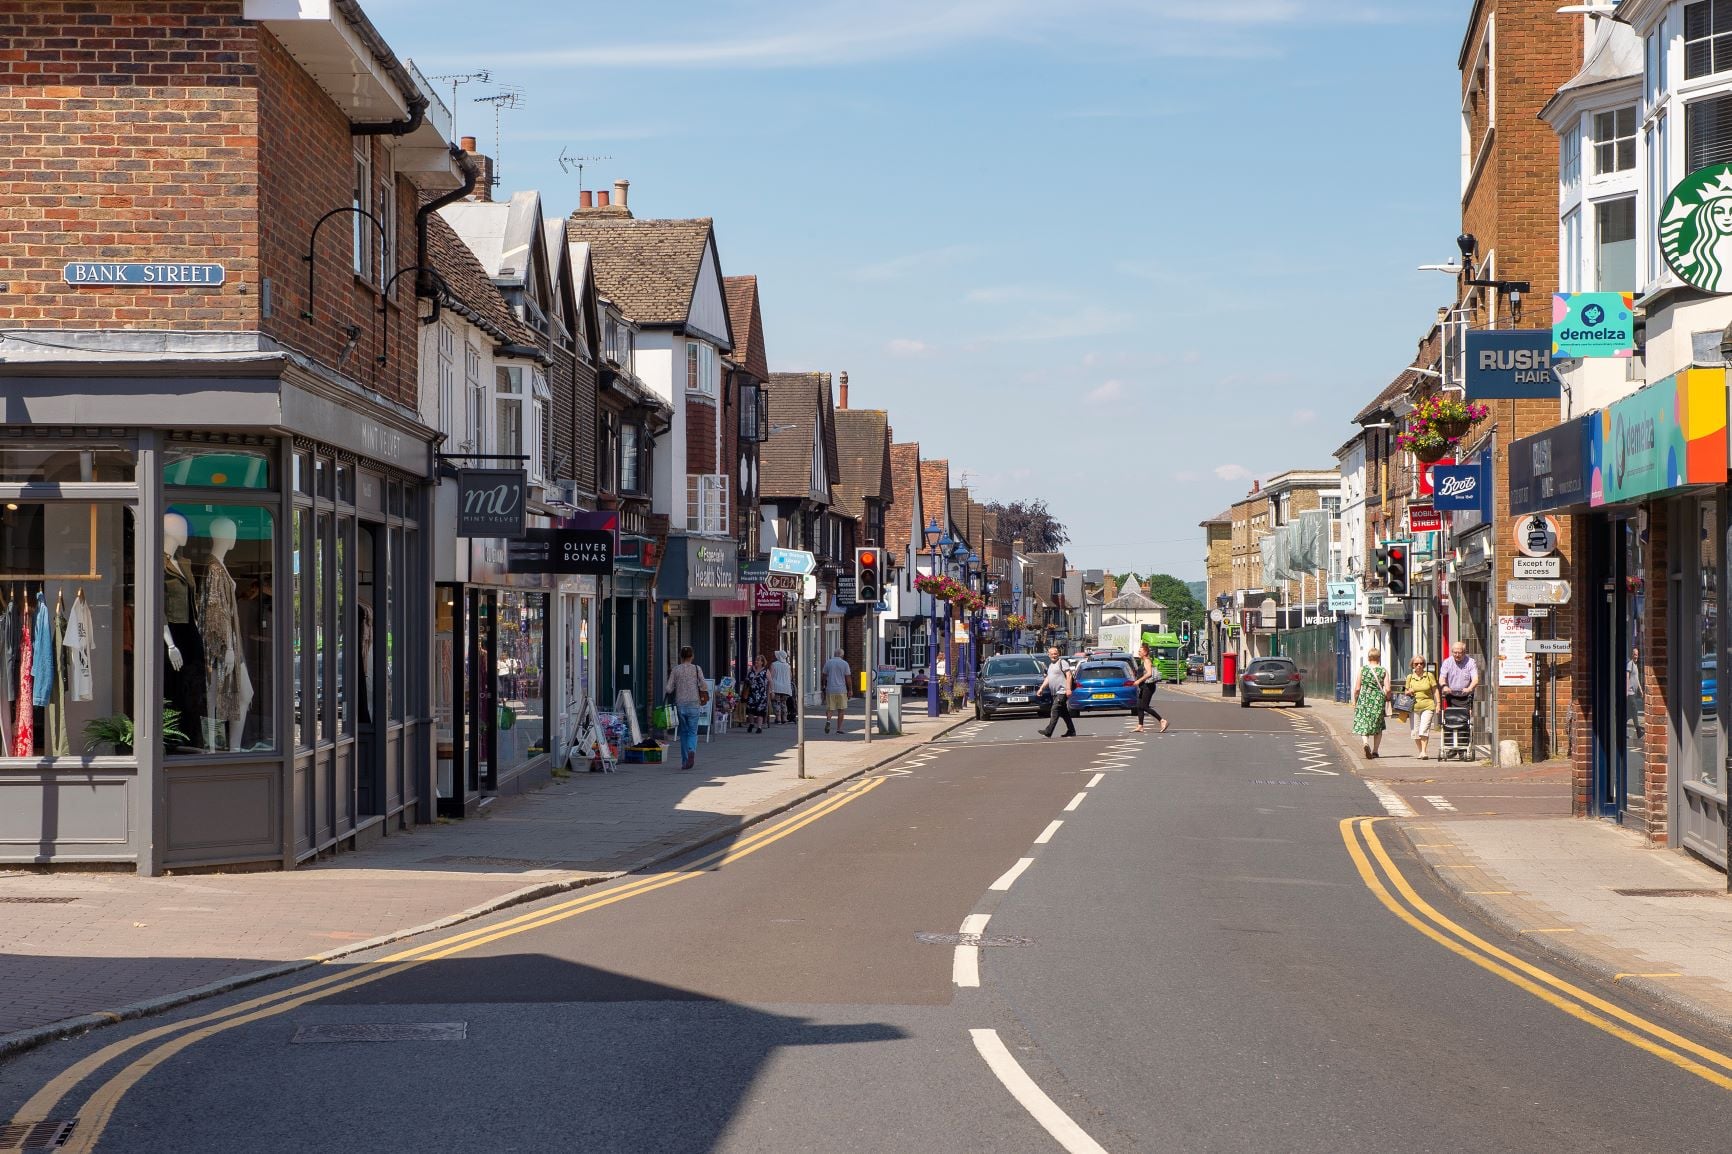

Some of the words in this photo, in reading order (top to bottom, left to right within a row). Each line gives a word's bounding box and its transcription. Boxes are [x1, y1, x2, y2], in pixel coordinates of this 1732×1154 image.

[76, 266, 128, 281] BANK
[144, 266, 213, 282] STREET
[1560, 328, 1626, 340] demelza
[1479, 350, 1550, 370] RUSH
[1515, 371, 1550, 383] HAIR
[362, 423, 378, 451] MINT
[379, 430, 400, 459] VELVET
[1626, 411, 1655, 456] demelza
[1438, 476, 1476, 496] Boots
[488, 516, 520, 524] VELVET
[564, 542, 607, 552] OLIVER
[564, 553, 607, 562] BONAS
[703, 547, 724, 565] Especially
[1517, 560, 1543, 568] Except
[695, 565, 715, 588] Health
[716, 567, 732, 588] Store
